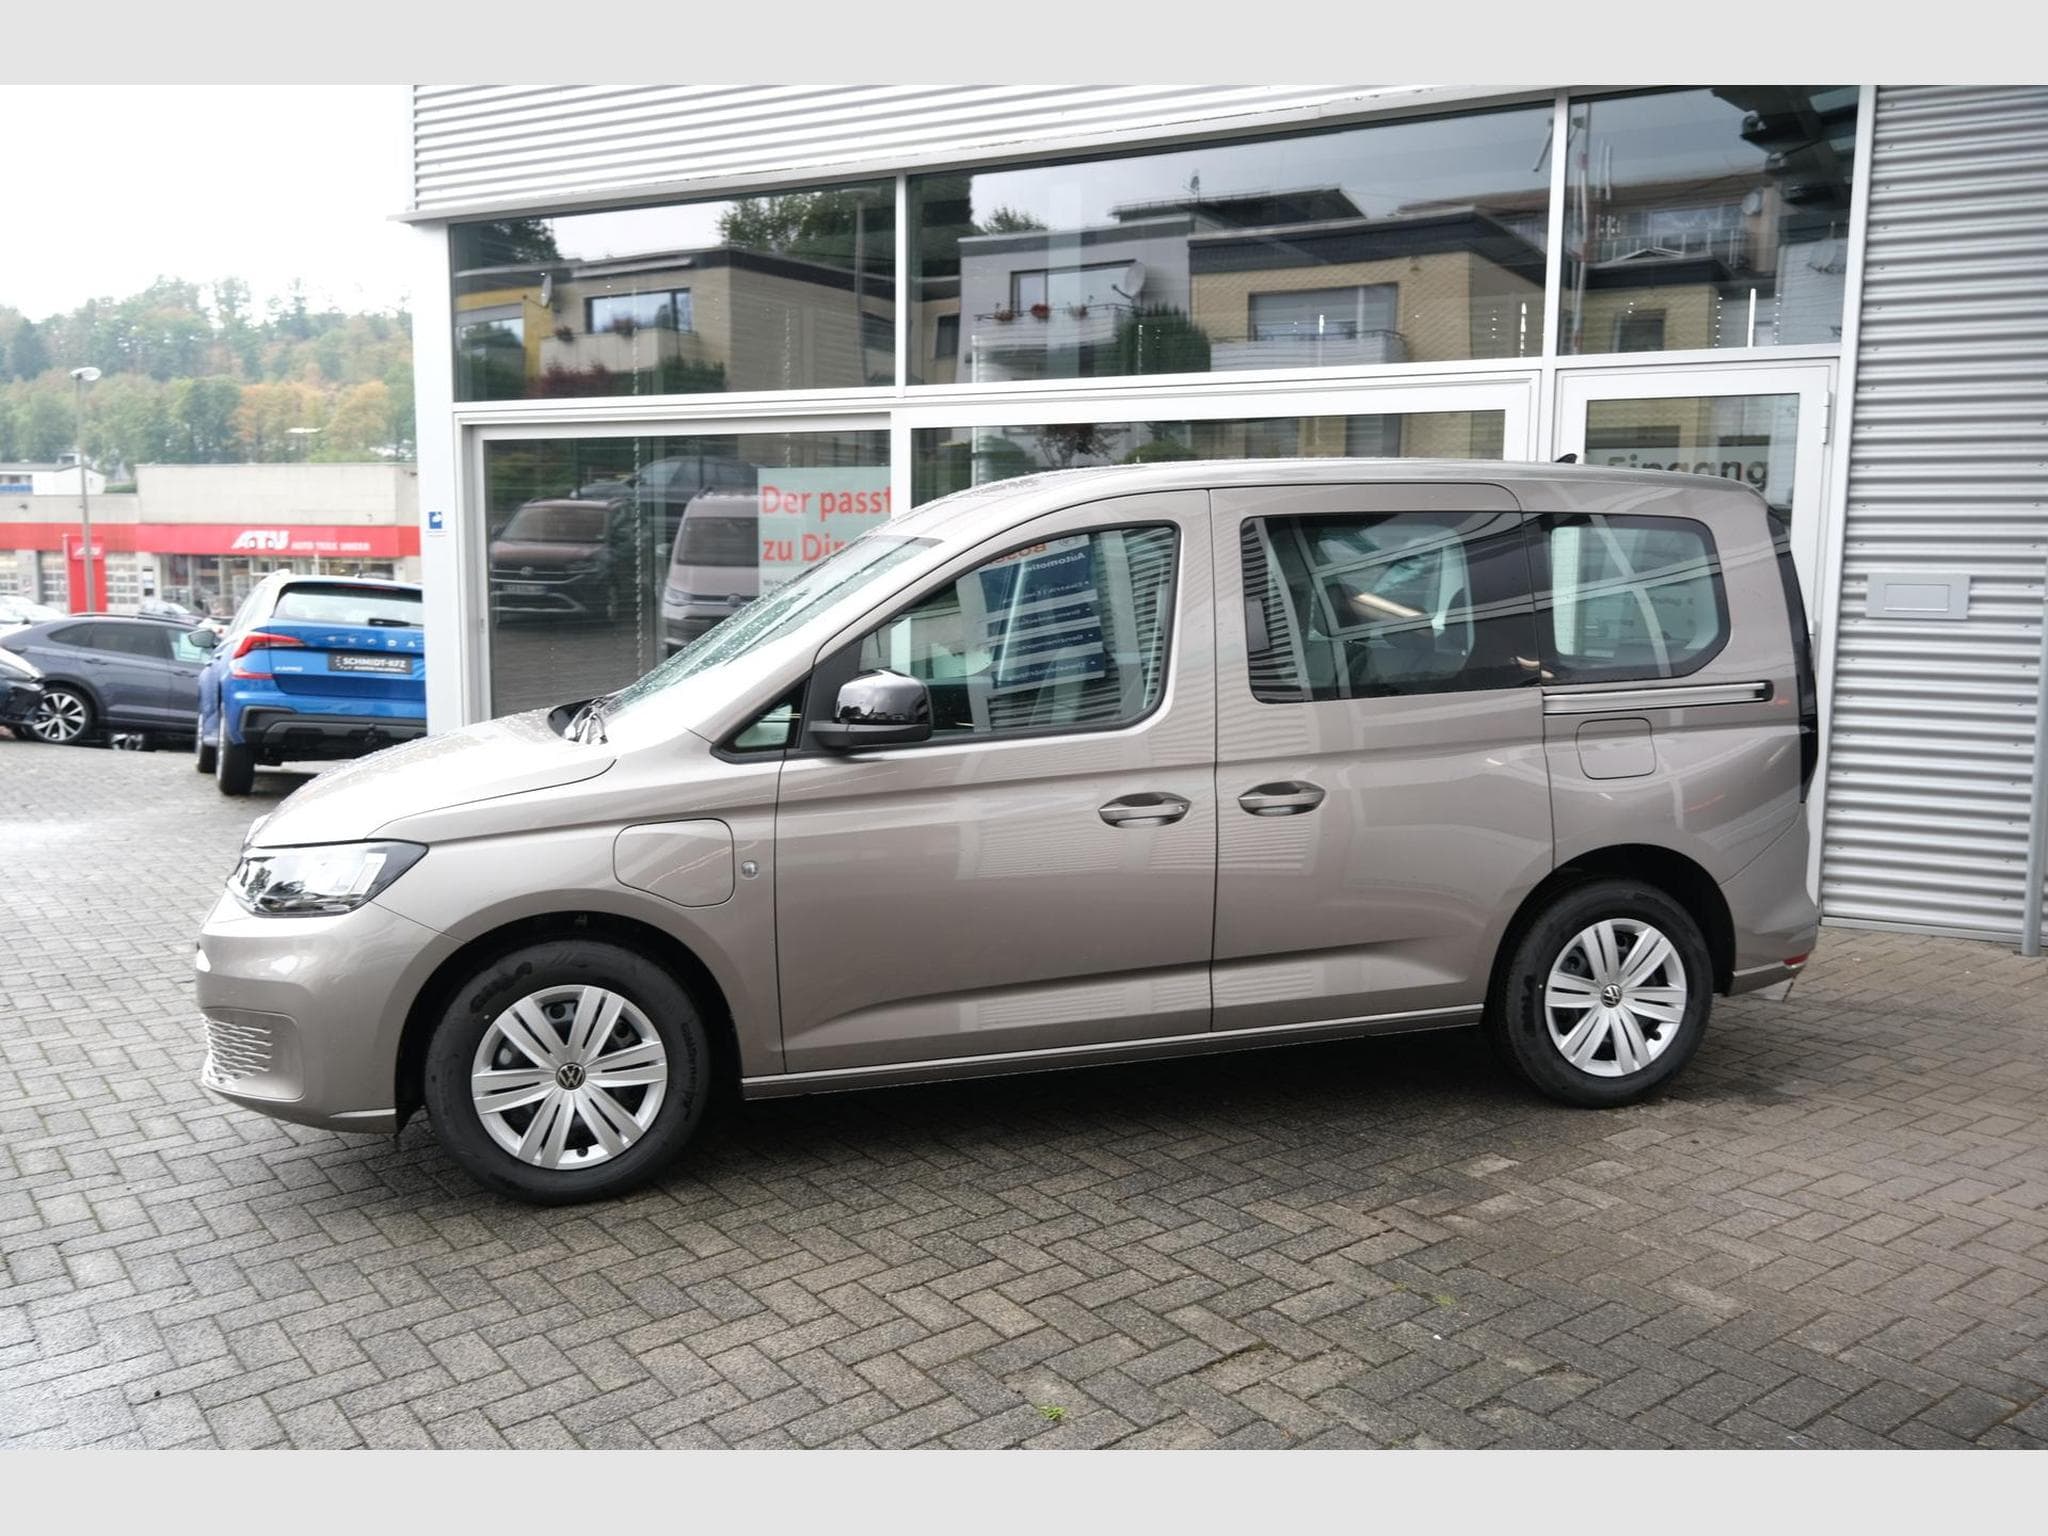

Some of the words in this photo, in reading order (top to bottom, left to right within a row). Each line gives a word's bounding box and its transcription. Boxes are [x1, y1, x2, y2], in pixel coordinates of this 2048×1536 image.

[762, 485, 812, 514] Der
[819, 486, 892, 522] passt
[763, 540, 793, 561] zu
